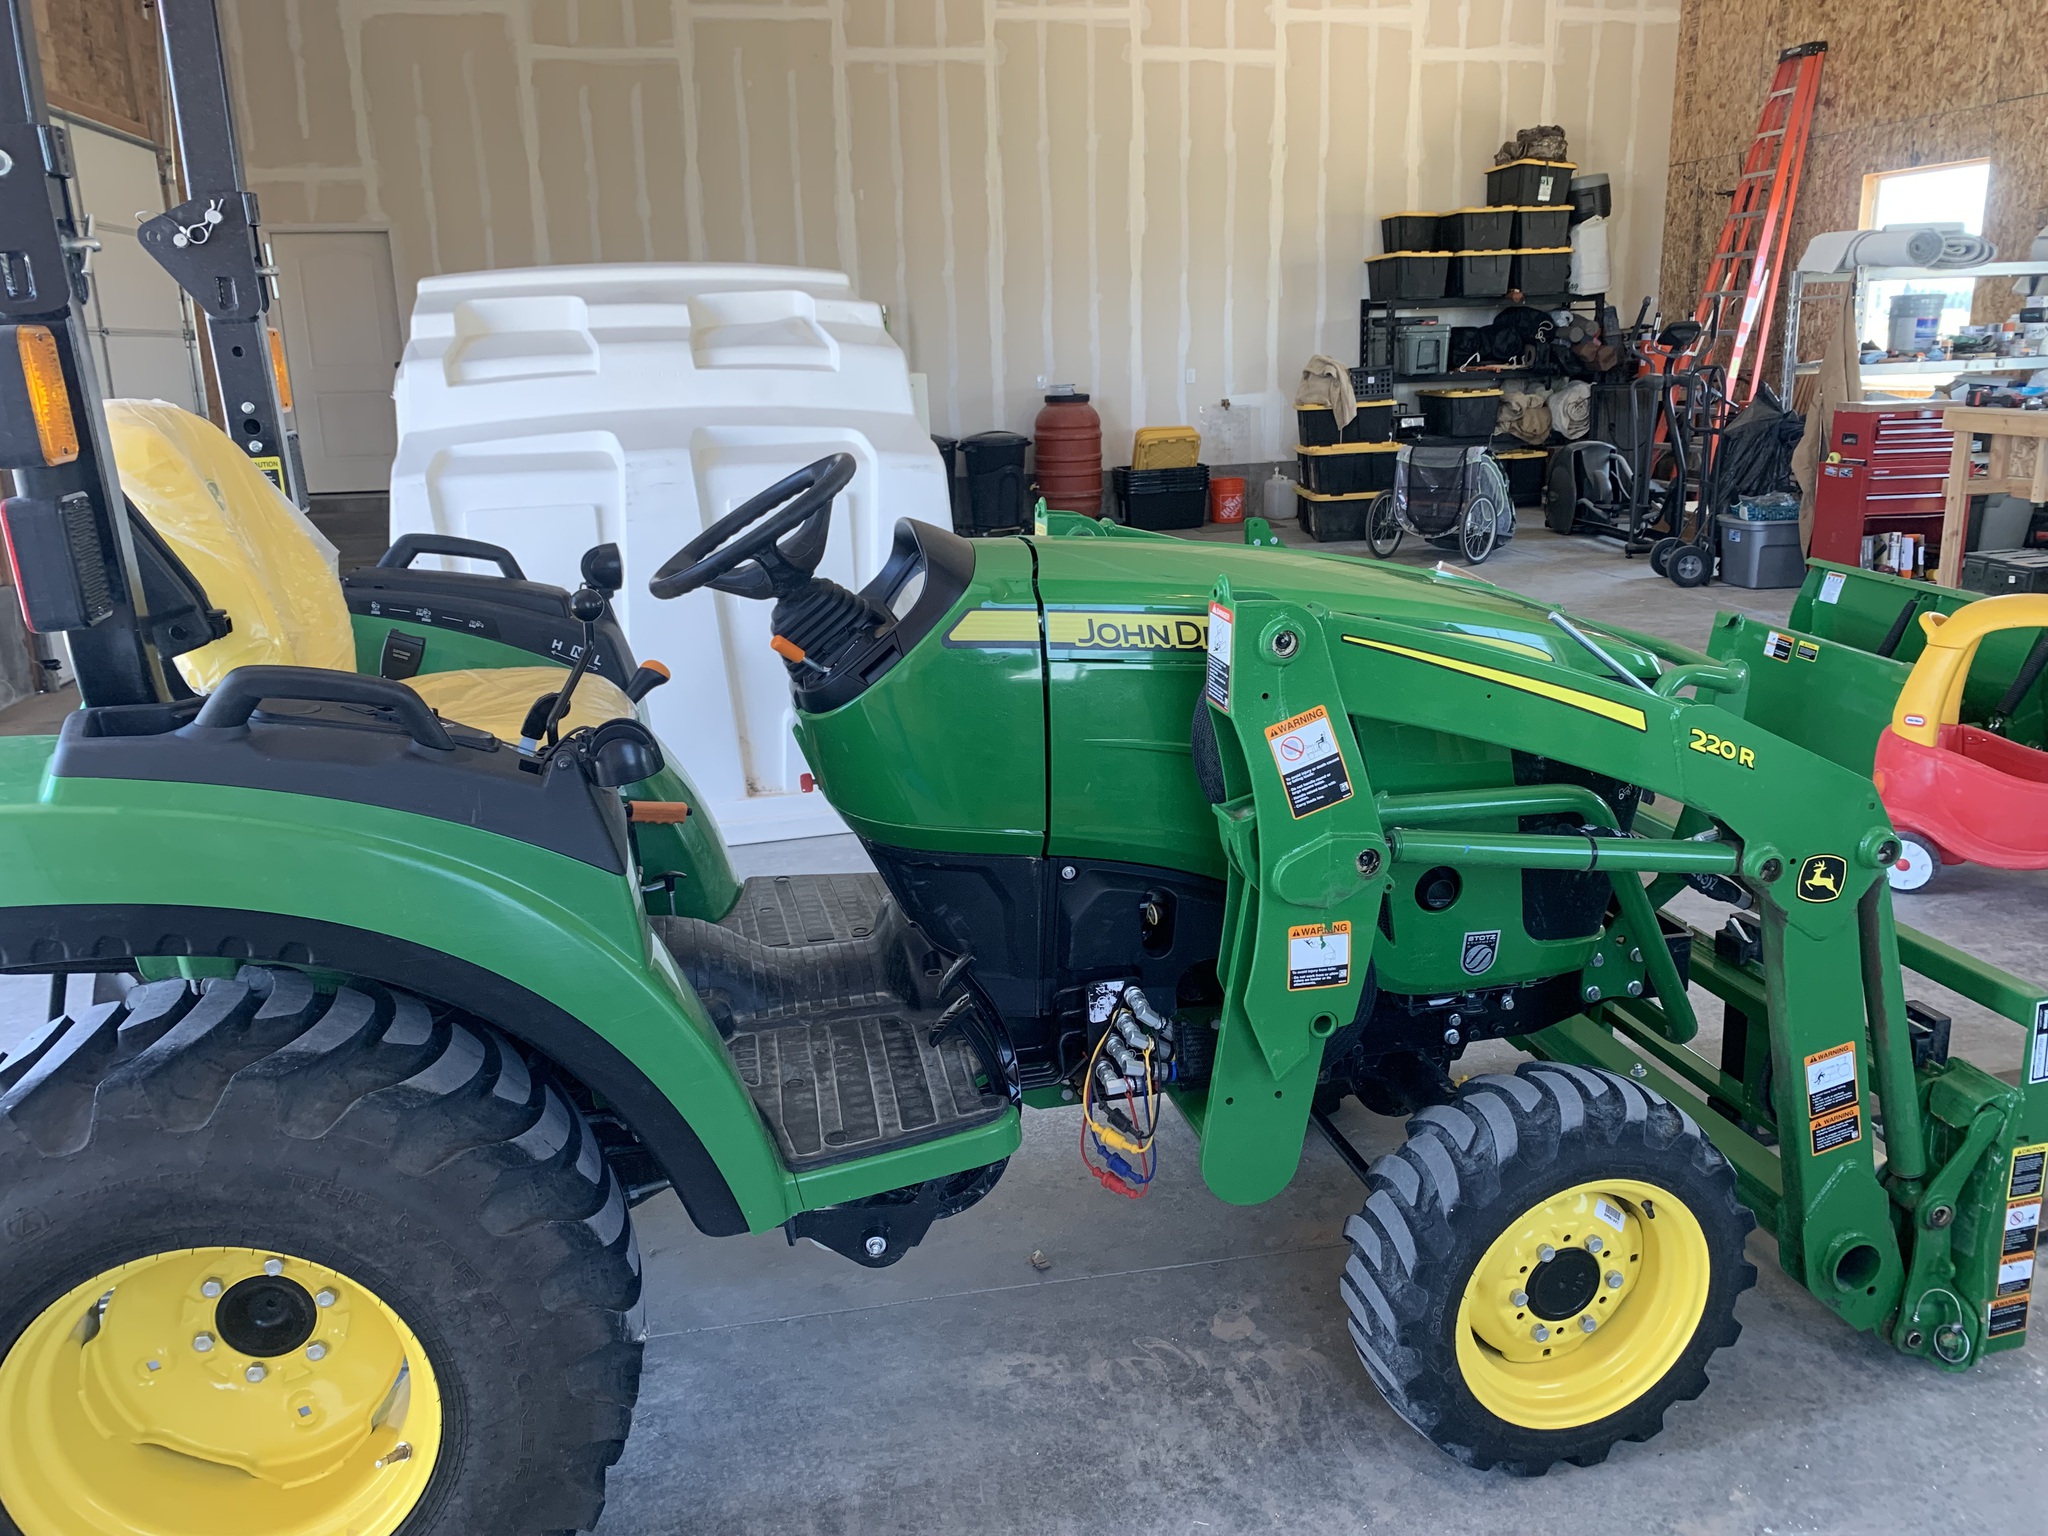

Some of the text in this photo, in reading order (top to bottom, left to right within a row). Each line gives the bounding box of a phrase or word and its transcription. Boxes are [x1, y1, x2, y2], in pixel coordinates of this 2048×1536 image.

[1078, 618, 1170, 645] JOHN
[552, 638, 563, 650] H
[594, 654, 601, 666] L
[1278, 708, 1324, 733] WARNING
[1690, 728, 1754, 769] 220 R
[1301, 924, 1347, 936] WARNG
[1818, 1045, 1849, 1060] WARNING
[1824, 1110, 1854, 1124] WARNING
[2022, 1146, 2045, 1154] CAUTION
[2000, 1296, 2026, 1306] WARNING
